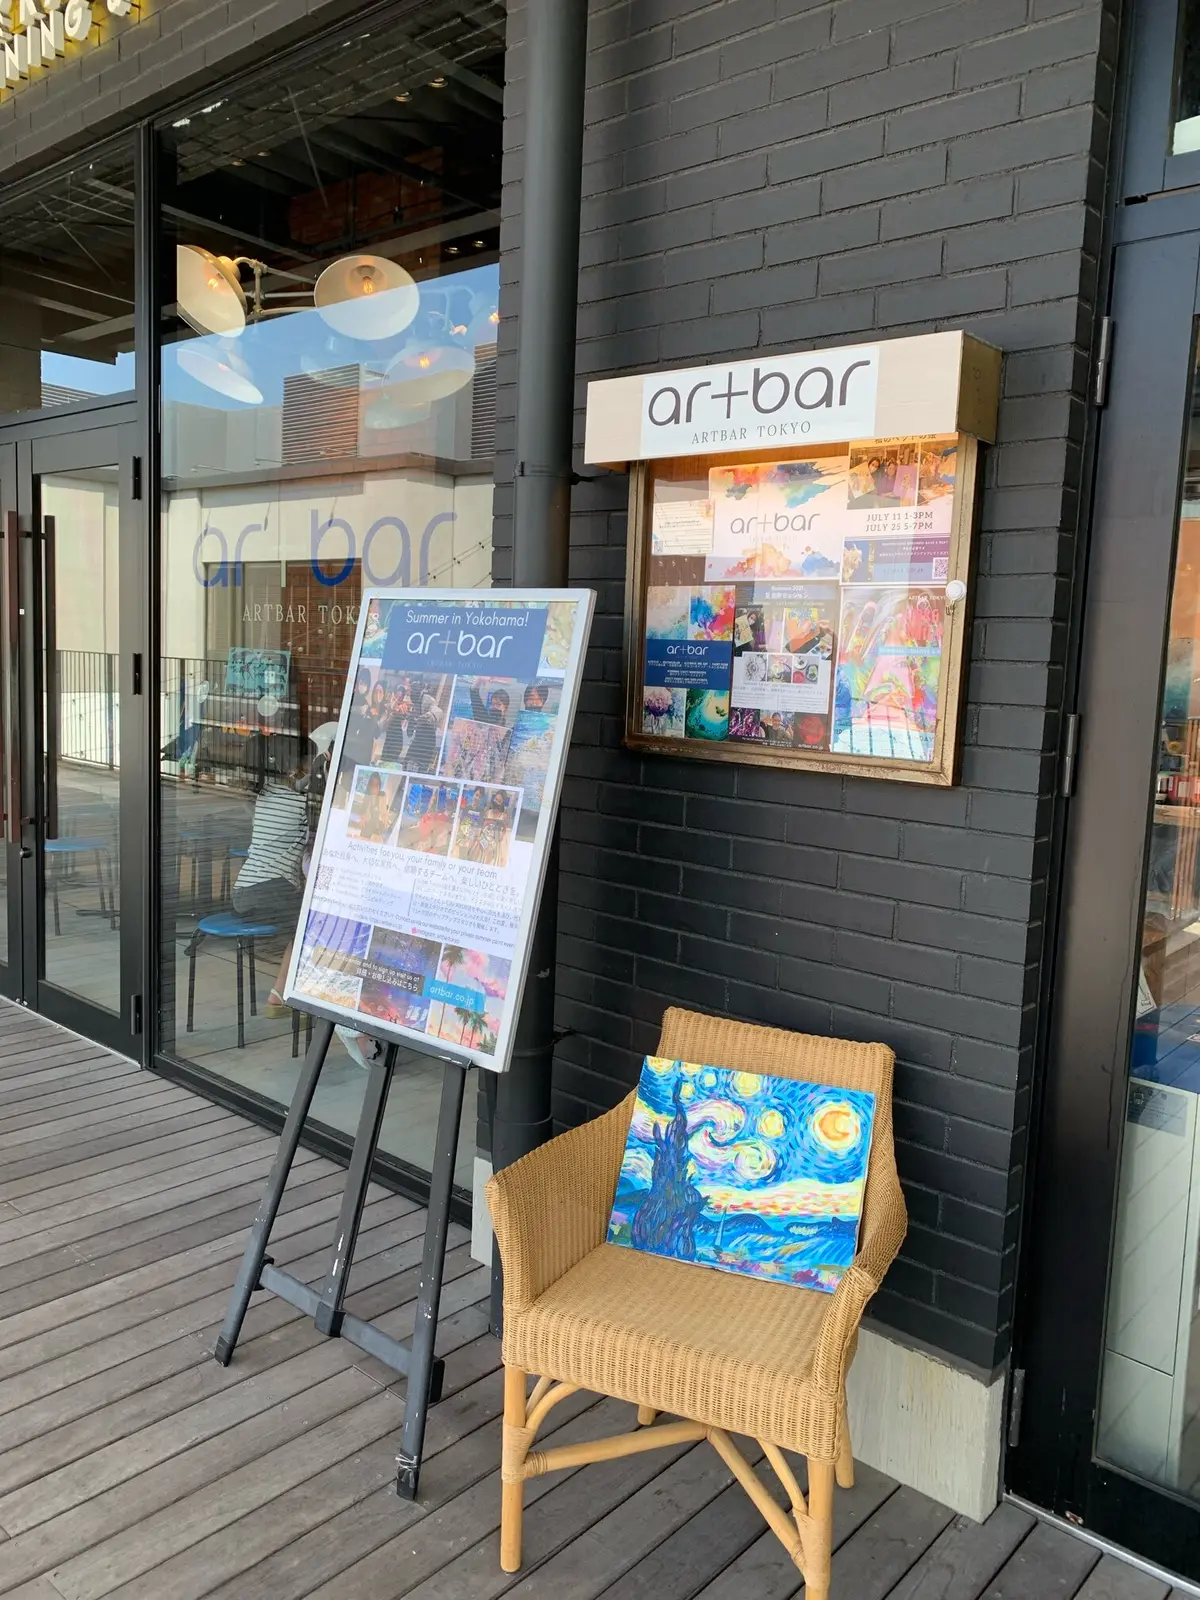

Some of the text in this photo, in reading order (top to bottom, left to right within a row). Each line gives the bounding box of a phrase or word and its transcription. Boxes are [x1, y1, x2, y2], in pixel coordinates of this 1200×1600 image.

[691, 420, 811, 445] ARTBAR TOKYO
[866, 511, 934, 522] JULY 11 1-3PM
[866, 522, 934, 532] JULY 25 5-7PM
[242, 604, 360, 625] ARTBAR TOK
[406, 610, 530, 627] Summer in Yokohama!
[346, 841, 378, 855] Activities
[380, 846, 390, 858] for
[405, 855, 423, 866] your
[424, 855, 446, 871] family
[457, 866, 475, 875] your
[476, 867, 498, 880] team
[362, 960, 372, 968] and
[430, 984, 474, 1007] artbar.co.jp
